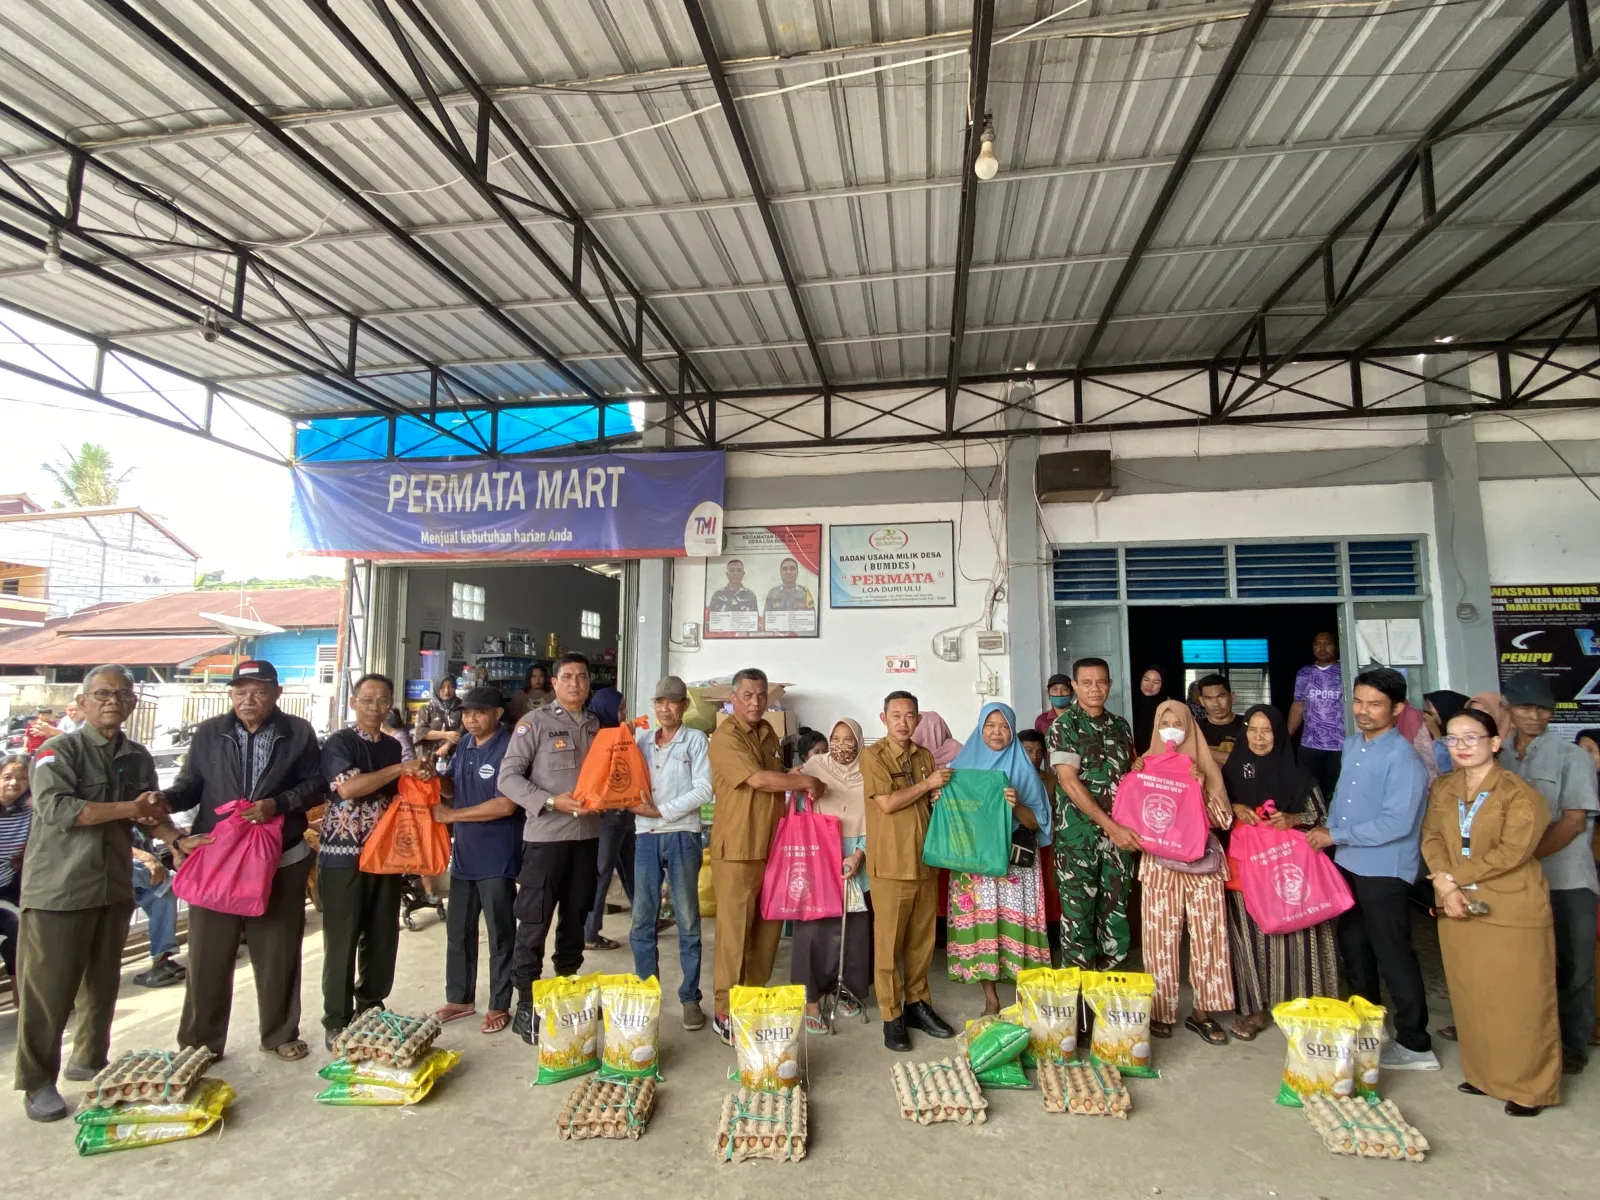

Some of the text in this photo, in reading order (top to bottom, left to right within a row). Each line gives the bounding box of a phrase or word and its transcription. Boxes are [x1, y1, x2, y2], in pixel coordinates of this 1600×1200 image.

[387, 466, 625, 513] PERMATA MART
[695, 517, 716, 535] TMI
[421, 528, 573, 547] Menjual kebutuhan harian Anda
[870, 562, 910, 571] BUMDES
[851, 572, 935, 586] PERMATA
[1552, 586, 1599, 596] MODUS
[1505, 603, 1581, 611] MARKETPLACE
[898, 660, 910, 668] 70
[1500, 652, 1553, 663] PENIPU
[1310, 690, 1341, 700] SPORT
[561, 1007, 596, 1027] SPHP
[1040, 1004, 1075, 1018] SPHP
[1108, 1010, 1146, 1023] SPHP
[614, 1014, 649, 1028] SPHP
[755, 1027, 793, 1041] SPHP
[1306, 1042, 1350, 1058] SPHP
